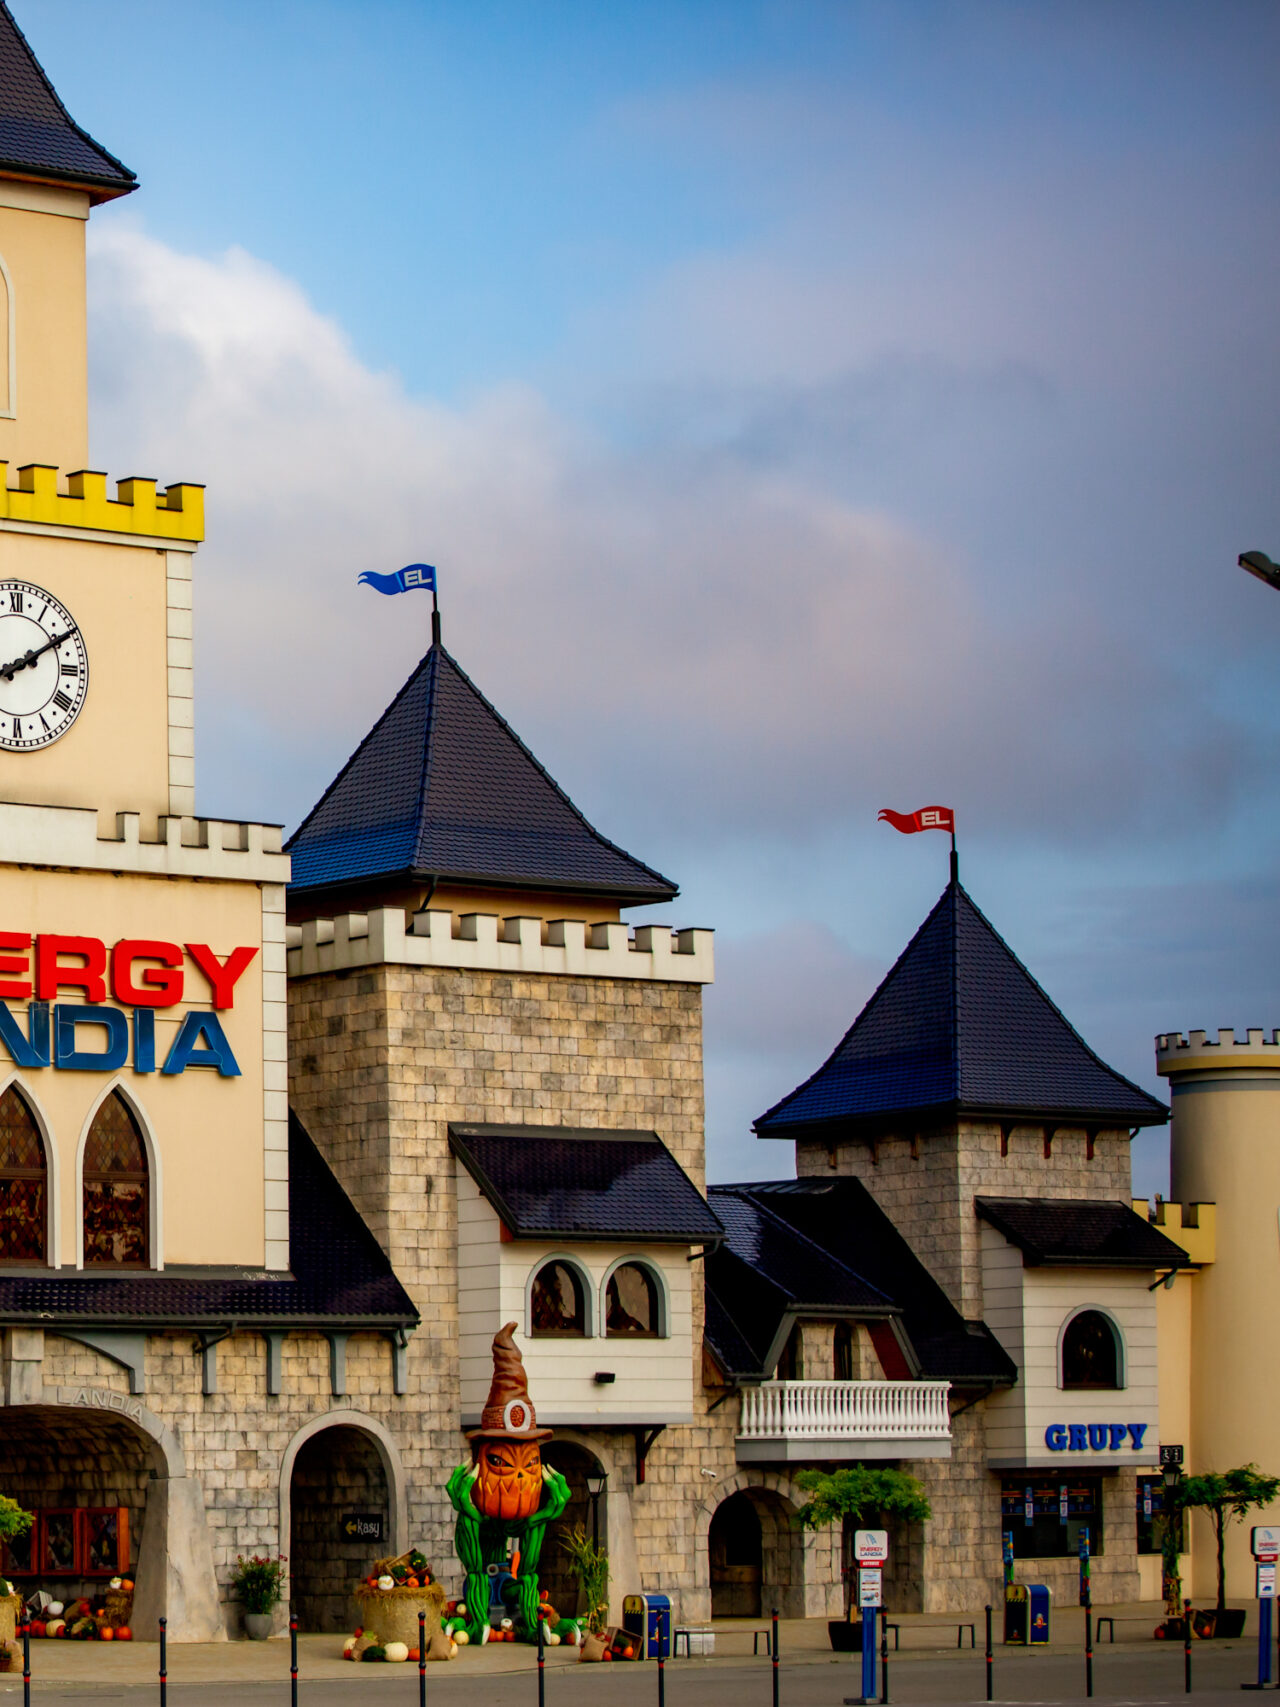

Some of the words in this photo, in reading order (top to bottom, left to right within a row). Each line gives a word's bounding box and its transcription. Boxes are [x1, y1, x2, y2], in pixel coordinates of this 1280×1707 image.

[404, 569, 433, 587] EL
[9, 591, 24, 613] XII
[60, 663, 78, 677] III
[921, 810, 950, 826] EL
[56, 1386, 144, 1425] LANDIA
[1045, 1423, 1148, 1451] GRUPY
[357, 1518, 379, 1538] kasy
